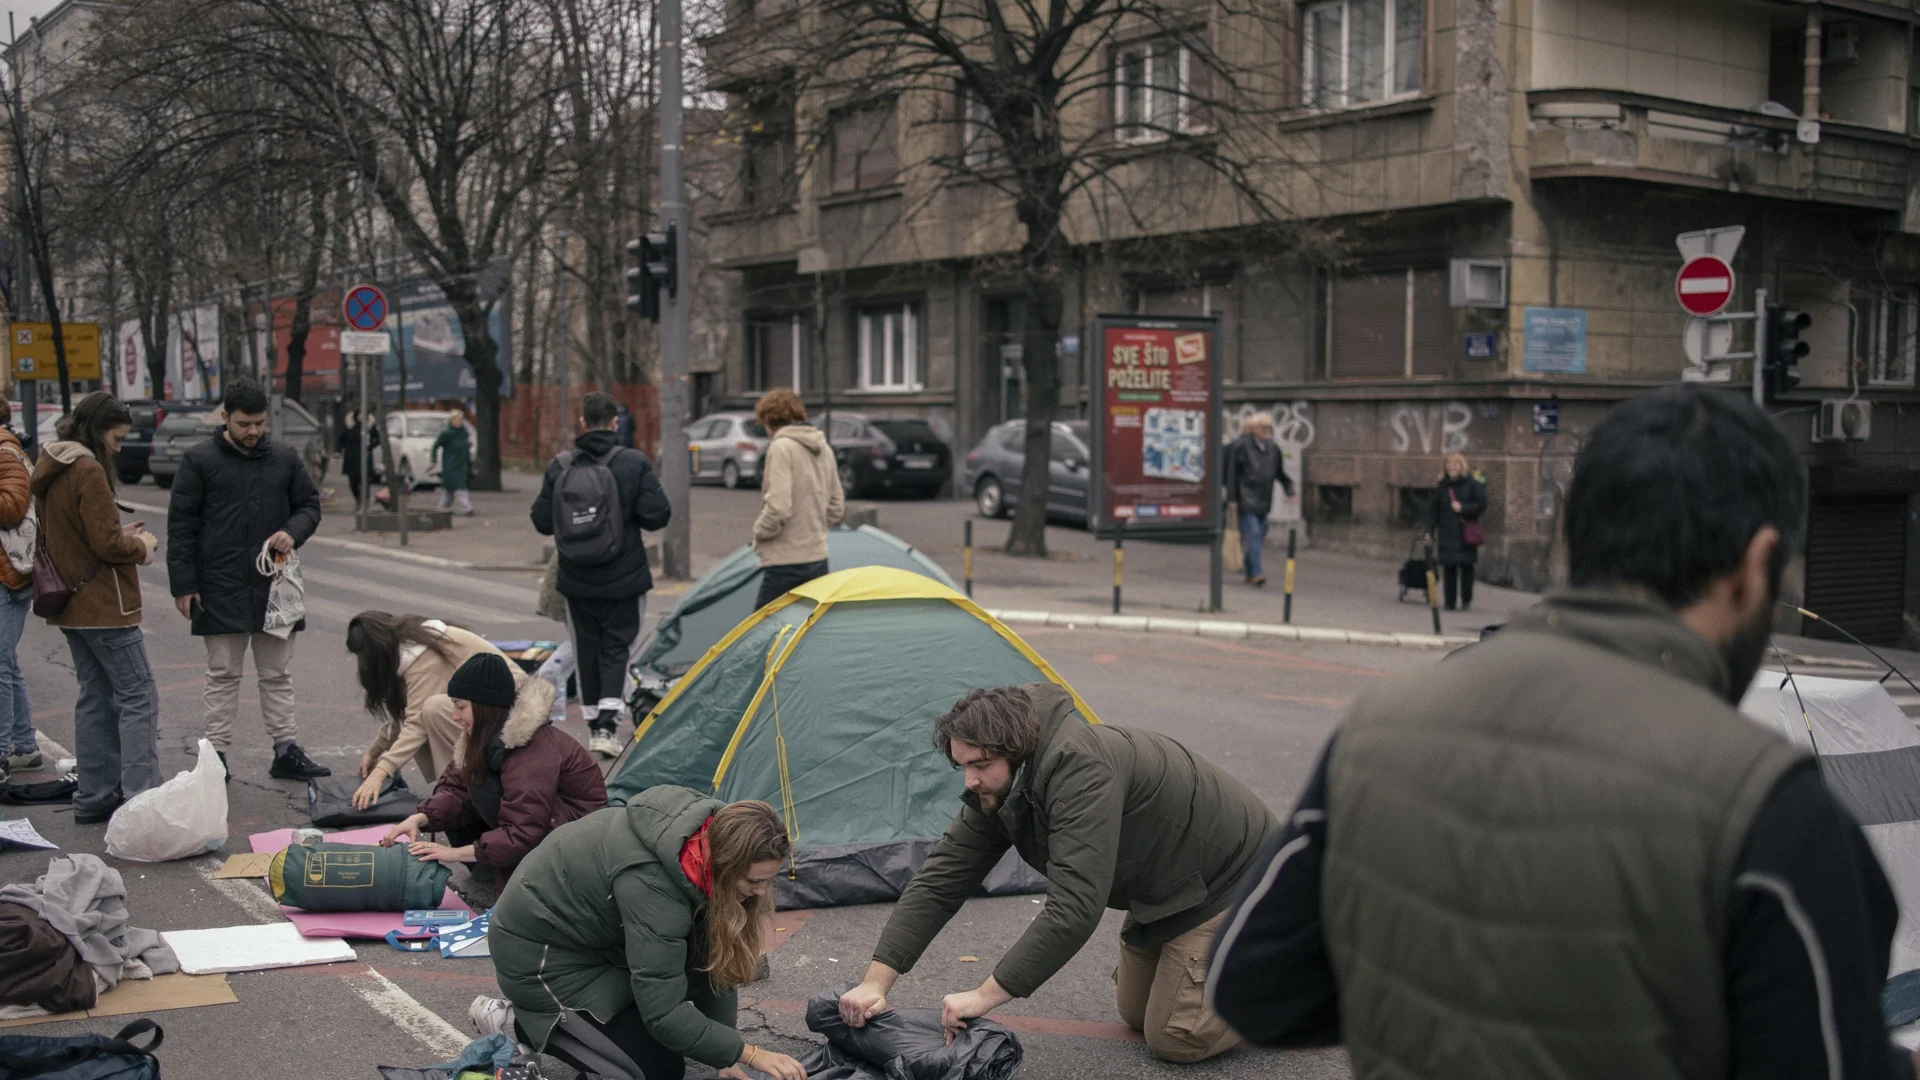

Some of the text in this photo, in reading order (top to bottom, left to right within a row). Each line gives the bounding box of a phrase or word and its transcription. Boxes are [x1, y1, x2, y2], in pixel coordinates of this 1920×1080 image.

[1112, 345, 1139, 366] SVE
[1143, 341, 1169, 367] ŠTO
[1107, 364, 1172, 390] POŽELITE
